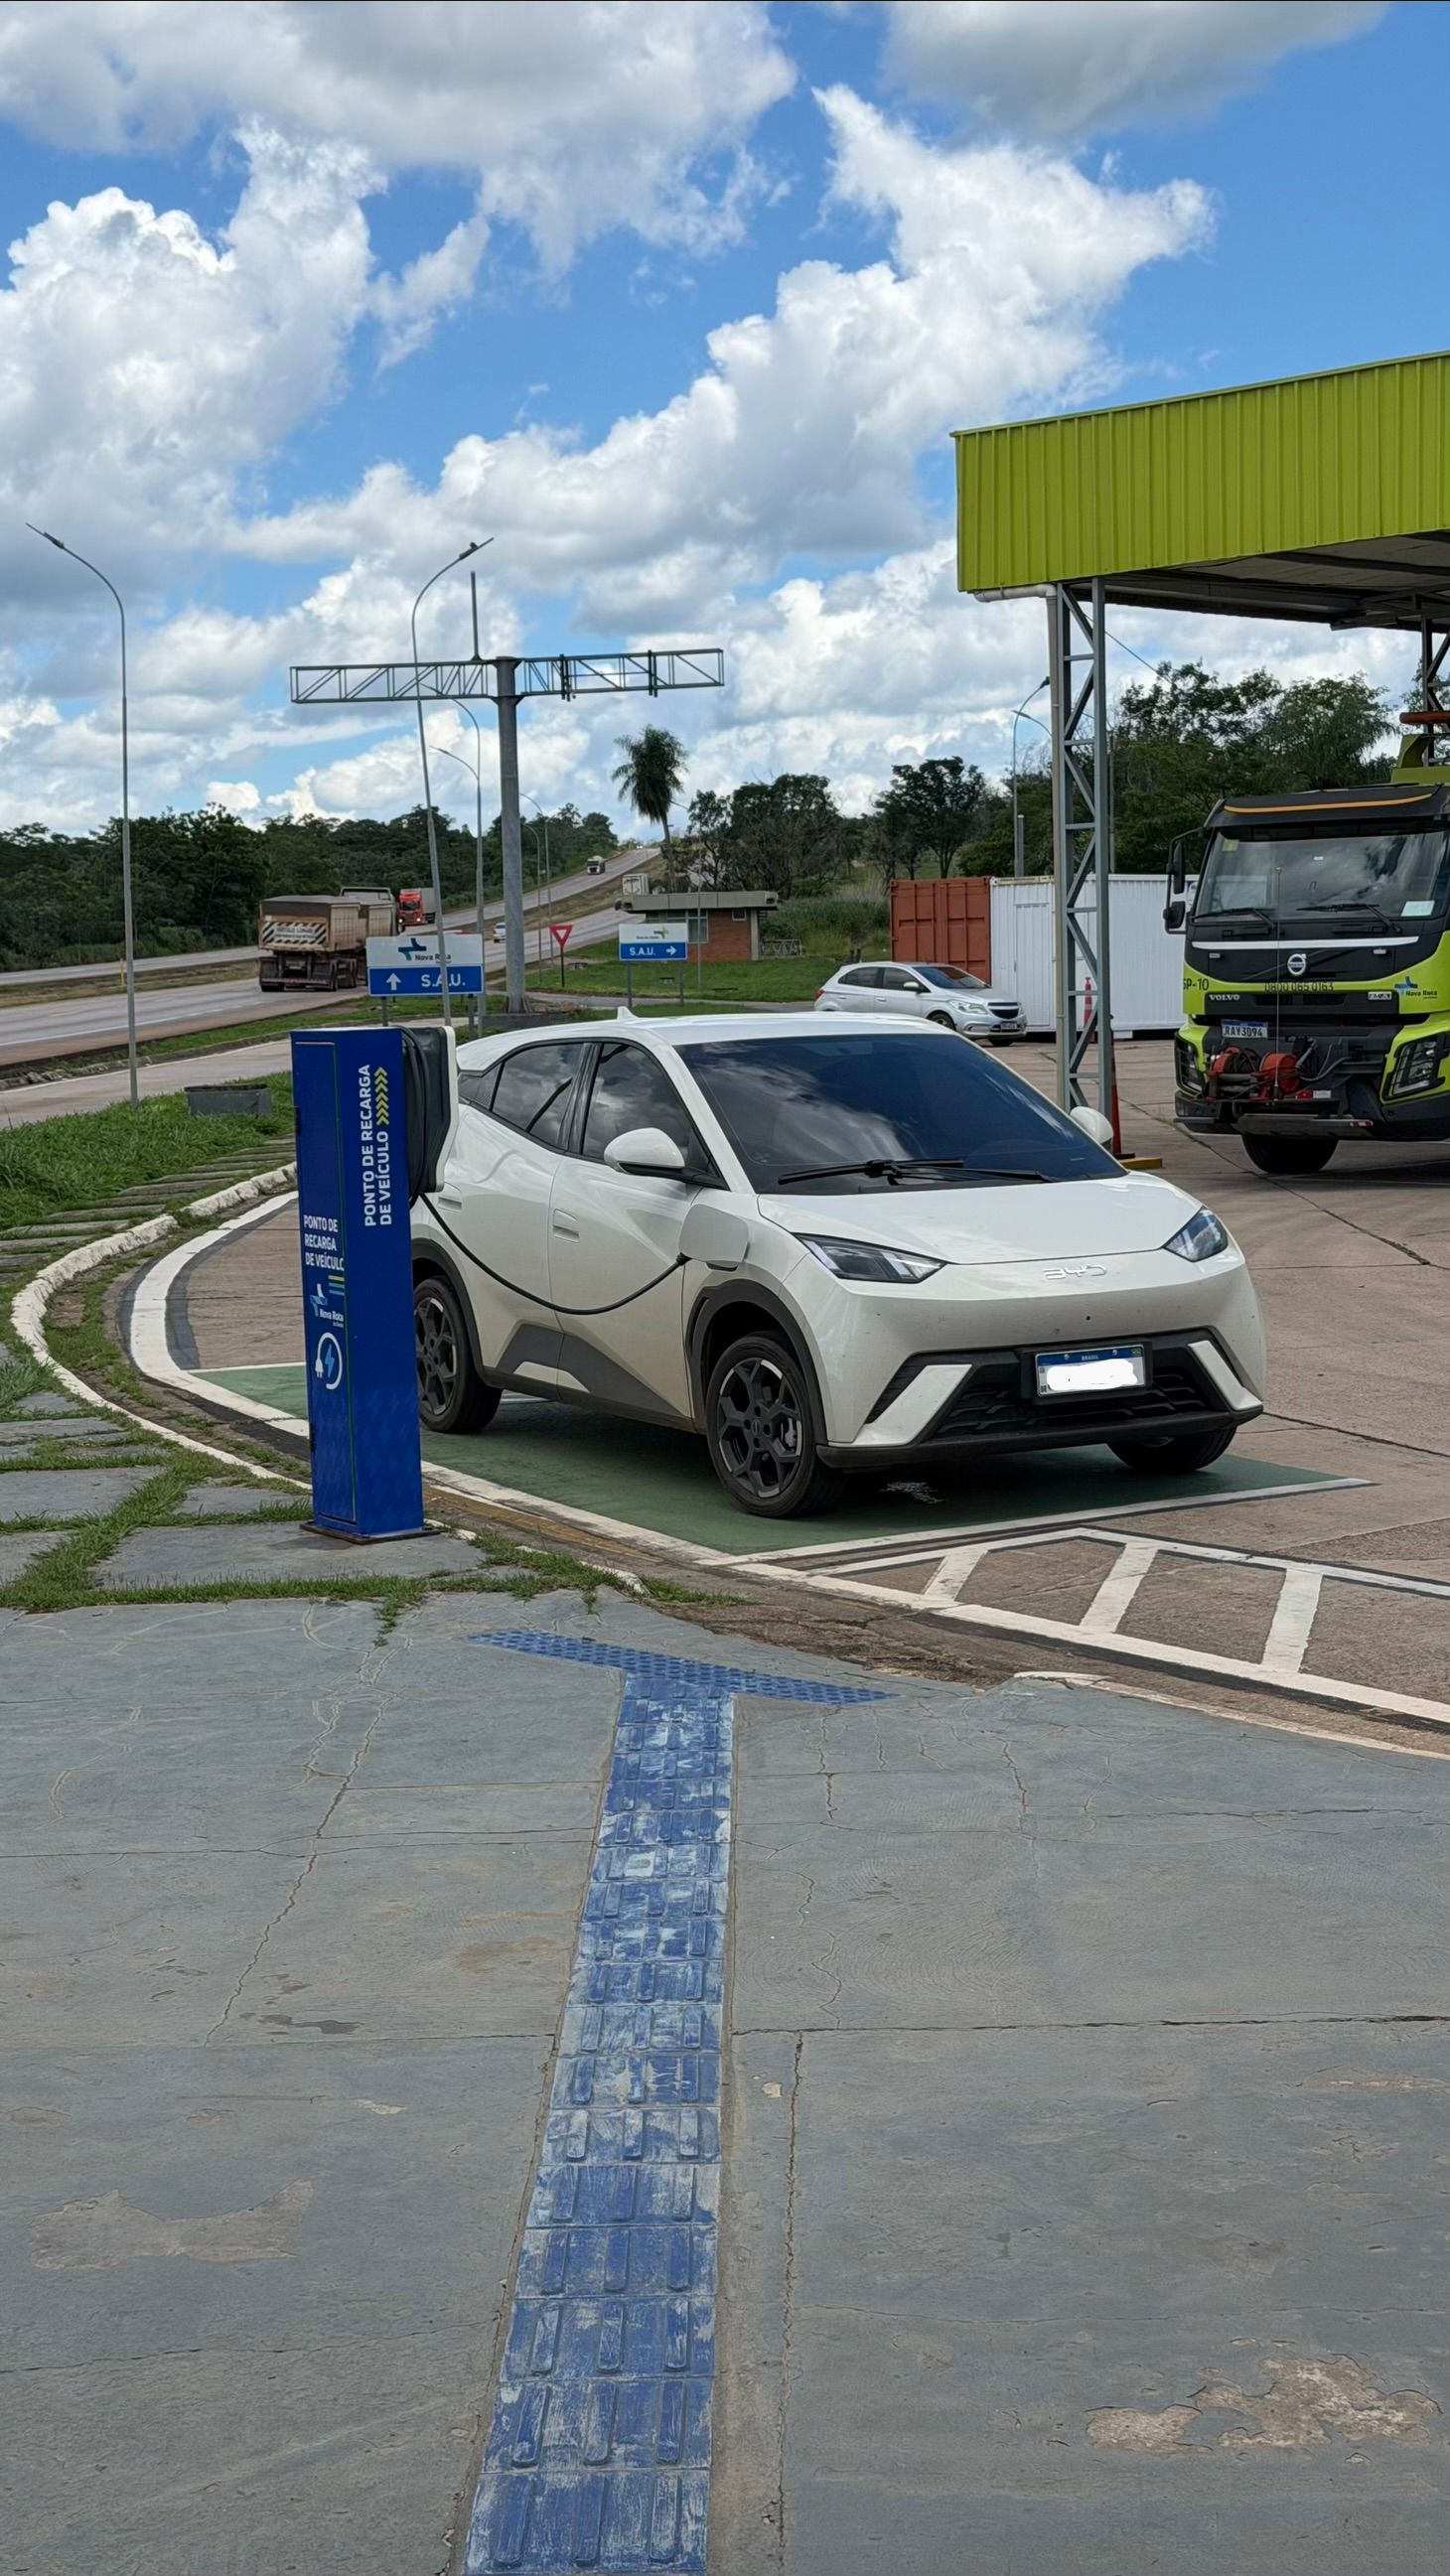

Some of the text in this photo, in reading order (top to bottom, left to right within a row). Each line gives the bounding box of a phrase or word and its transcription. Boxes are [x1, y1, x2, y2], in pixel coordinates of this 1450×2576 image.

[358, 1065, 376, 1226] PONTO DE RECARGA
[374, 1130, 392, 1225] DE VEÍCULO
[303, 1214, 339, 1233] PONTO DE
[304, 1232, 338, 1251] RECARGA
[305, 1251, 315, 1267] DE
[1043, 1264, 1107, 1280] BYD
